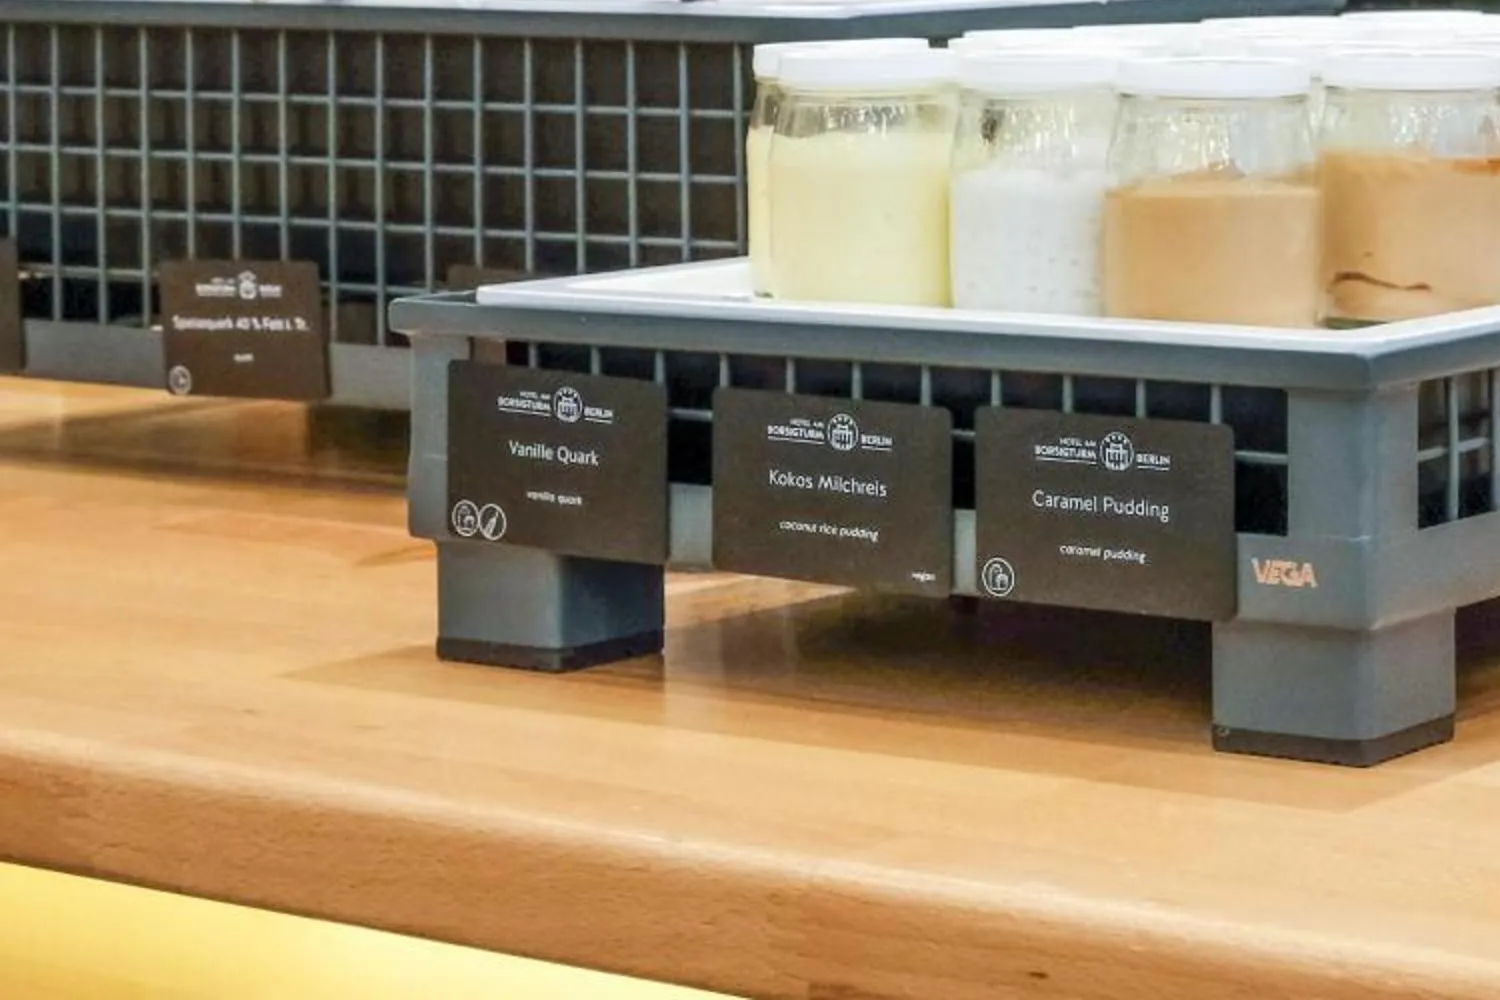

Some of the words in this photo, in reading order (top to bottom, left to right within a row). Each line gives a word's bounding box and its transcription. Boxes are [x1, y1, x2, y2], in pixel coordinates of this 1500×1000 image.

[768, 425, 825, 440] BORSIGTURM
[861, 433, 893, 446] BERLIN
[508, 440, 553, 461] Vanille
[557, 445, 599, 466] Quark
[1035, 444, 1097, 459] BORSIGTURM
[1137, 453, 1171, 465] BERLIN
[769, 468, 813, 490] Kokos
[818, 474, 888, 498] Milchreis
[1032, 489, 1098, 513] Caramel
[1103, 495, 1169, 523] Pudding
[779, 520, 817, 533] coconut
[819, 524, 837, 536] rice
[839, 527, 879, 543] pudding
[1060, 545, 1101, 558] caramel
[1104, 549, 1147, 565] pudding
[1251, 557, 1318, 589] VEGA
